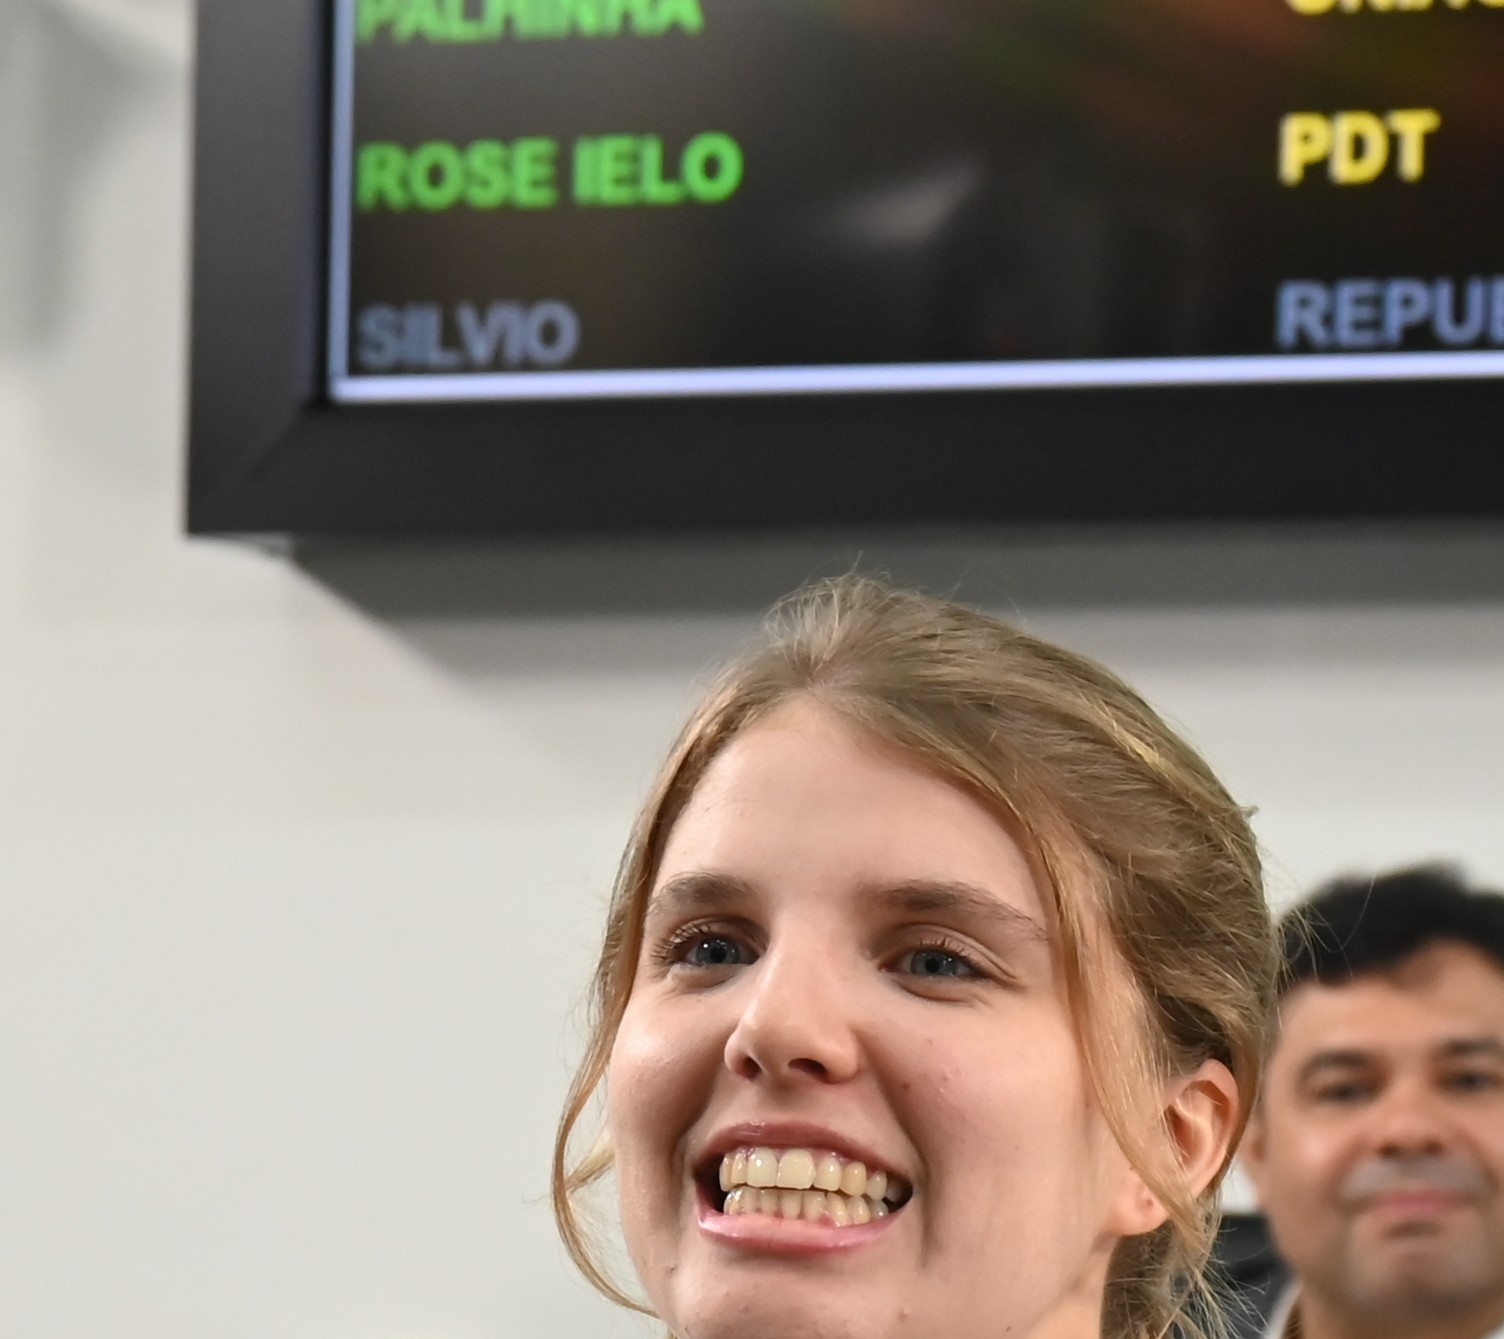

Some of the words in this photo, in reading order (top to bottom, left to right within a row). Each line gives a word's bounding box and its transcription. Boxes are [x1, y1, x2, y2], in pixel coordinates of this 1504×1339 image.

[355, 137, 559, 213] ROSE
[572, 131, 745, 206] IELO
[1278, 107, 1442, 187] PDT
[355, 300, 583, 368] SILVIO
